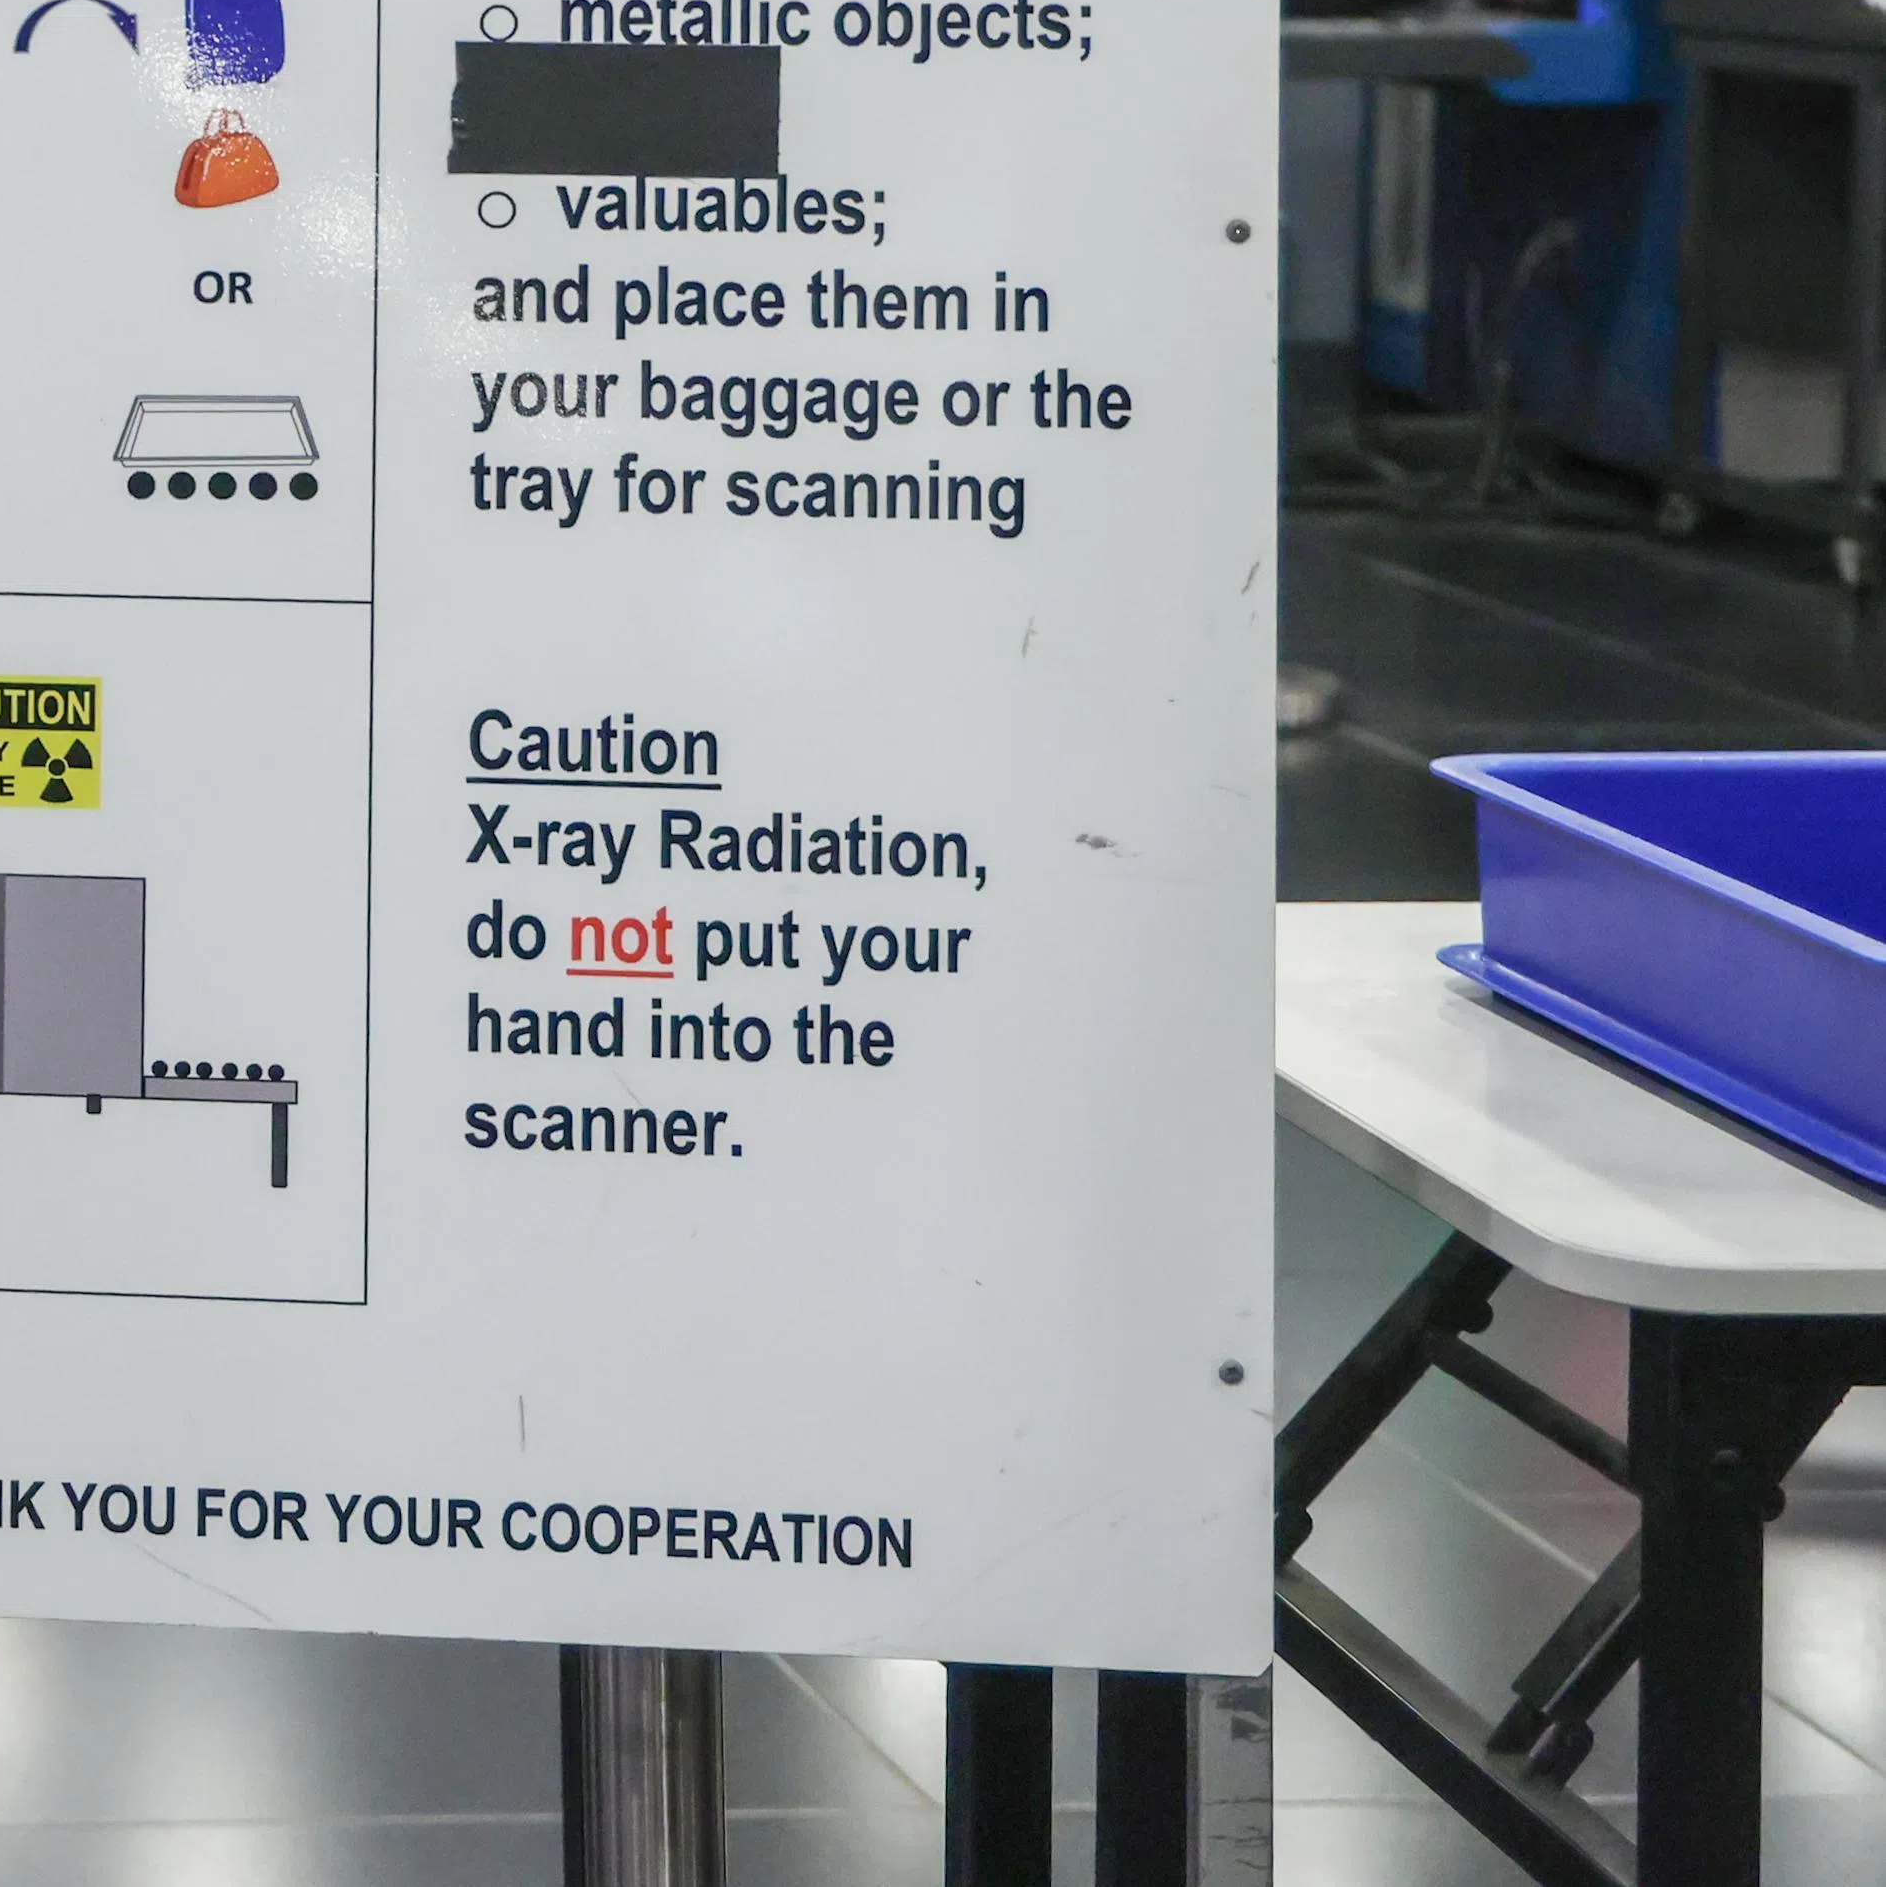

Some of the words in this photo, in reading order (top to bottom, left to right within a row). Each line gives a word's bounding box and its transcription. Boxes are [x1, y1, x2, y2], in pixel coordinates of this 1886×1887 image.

[557, 174, 885, 247] valuables;
[194, 271, 252, 303] OR
[474, 265, 588, 323] and
[616, 266, 784, 339] place
[807, 269, 967, 330] them
[996, 272, 1048, 331] in
[472, 373, 619, 432] your
[642, 360, 918, 440] baggage
[943, 381, 1010, 426] or
[1031, 369, 1131, 429] the
[471, 453, 593, 528] tray
[614, 453, 706, 514] for
[727, 460, 1024, 538] scanning
[468, 710, 719, 776] Caution
[467, 804, 636, 884] X-ray
[661, 810, 985, 891] Radiation,
[468, 899, 546, 960] do
[569, 907, 673, 965] not
[697, 911, 799, 981] put
[822, 925, 971, 985] your
[469, 993, 623, 1057] hand
[652, 998, 771, 1062] into
[794, 1004, 894, 1066] the
[465, 1103, 742, 1156] scanner.
[62, 1483, 175, 1535] YOU
[198, 1488, 309, 1541] FOR
[326, 1494, 483, 1548] YOUR
[502, 1502, 911, 1568] COOPERATION
